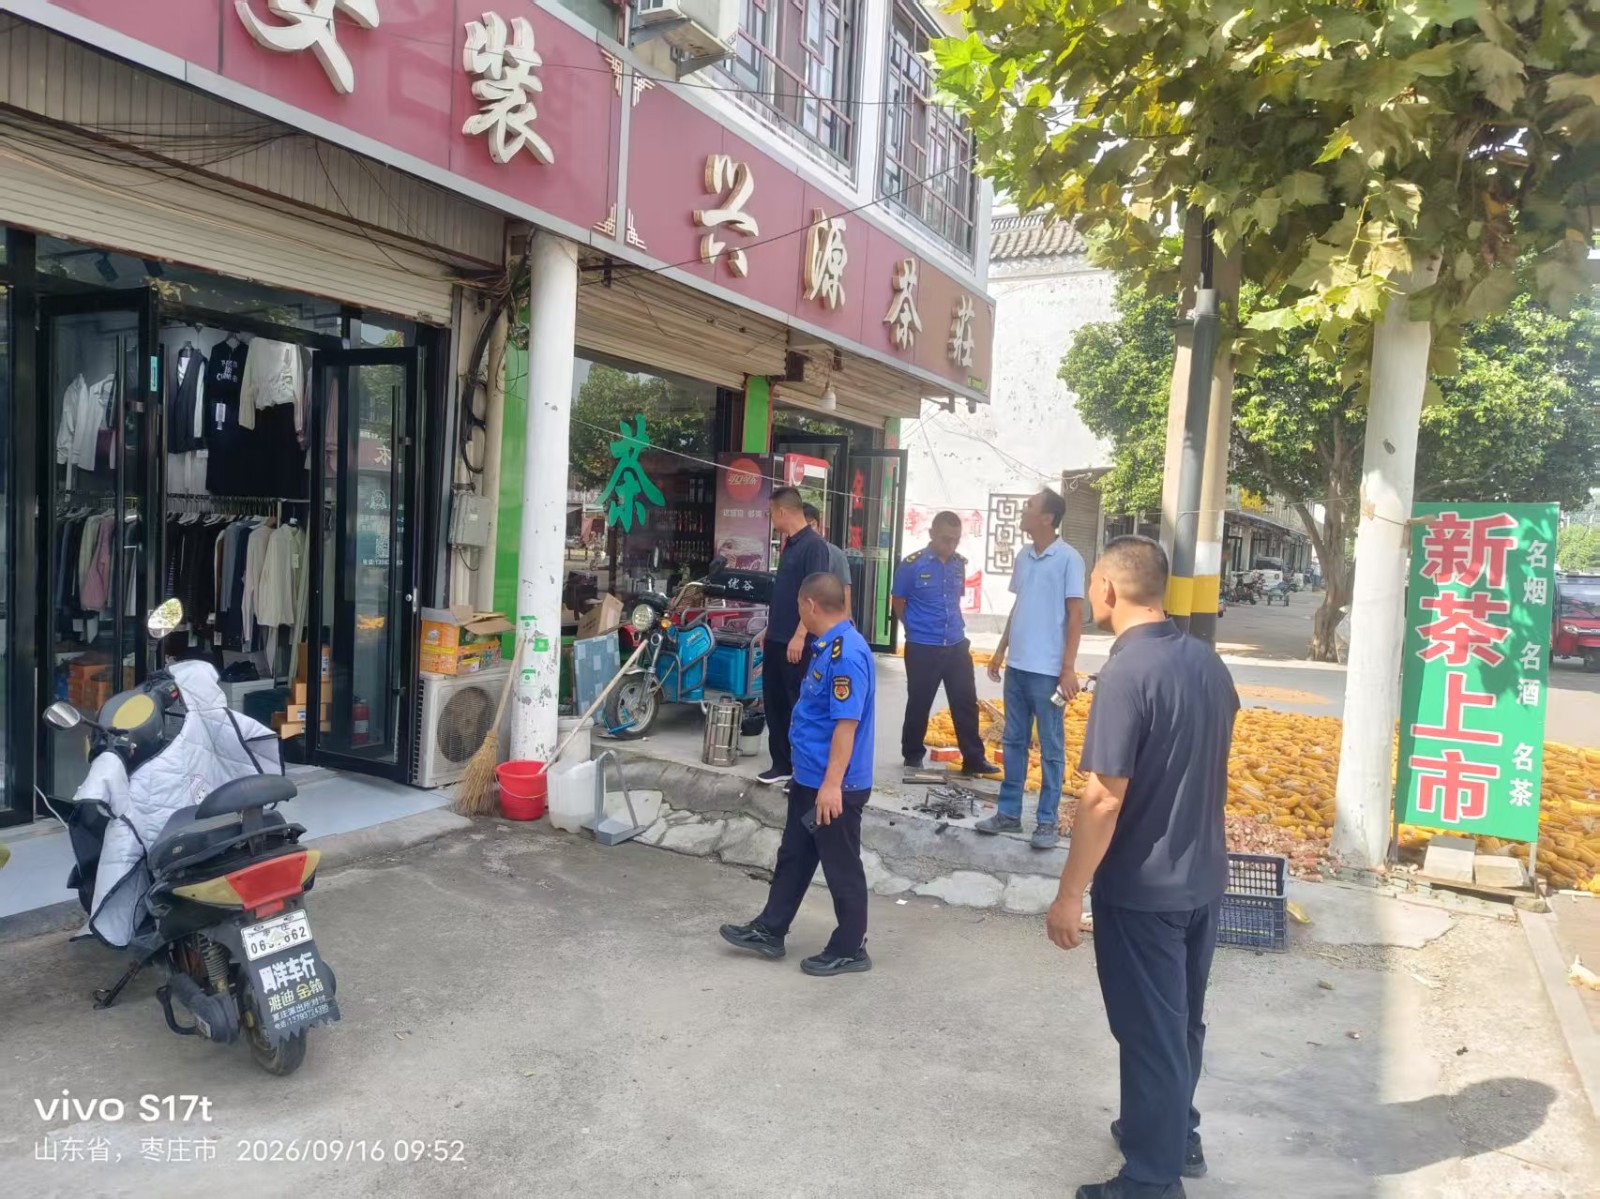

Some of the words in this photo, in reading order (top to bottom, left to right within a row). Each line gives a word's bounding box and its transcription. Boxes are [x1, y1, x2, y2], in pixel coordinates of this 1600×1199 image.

[595, 413, 667, 533] 茶
[1523, 540, 1548, 606] 名烟
[1411, 511, 1519, 824] 新茶上市
[1516, 642, 1541, 708] 名酒
[1509, 742, 1535, 808] 名茶
[268, 989, 296, 1013] 雅迪
